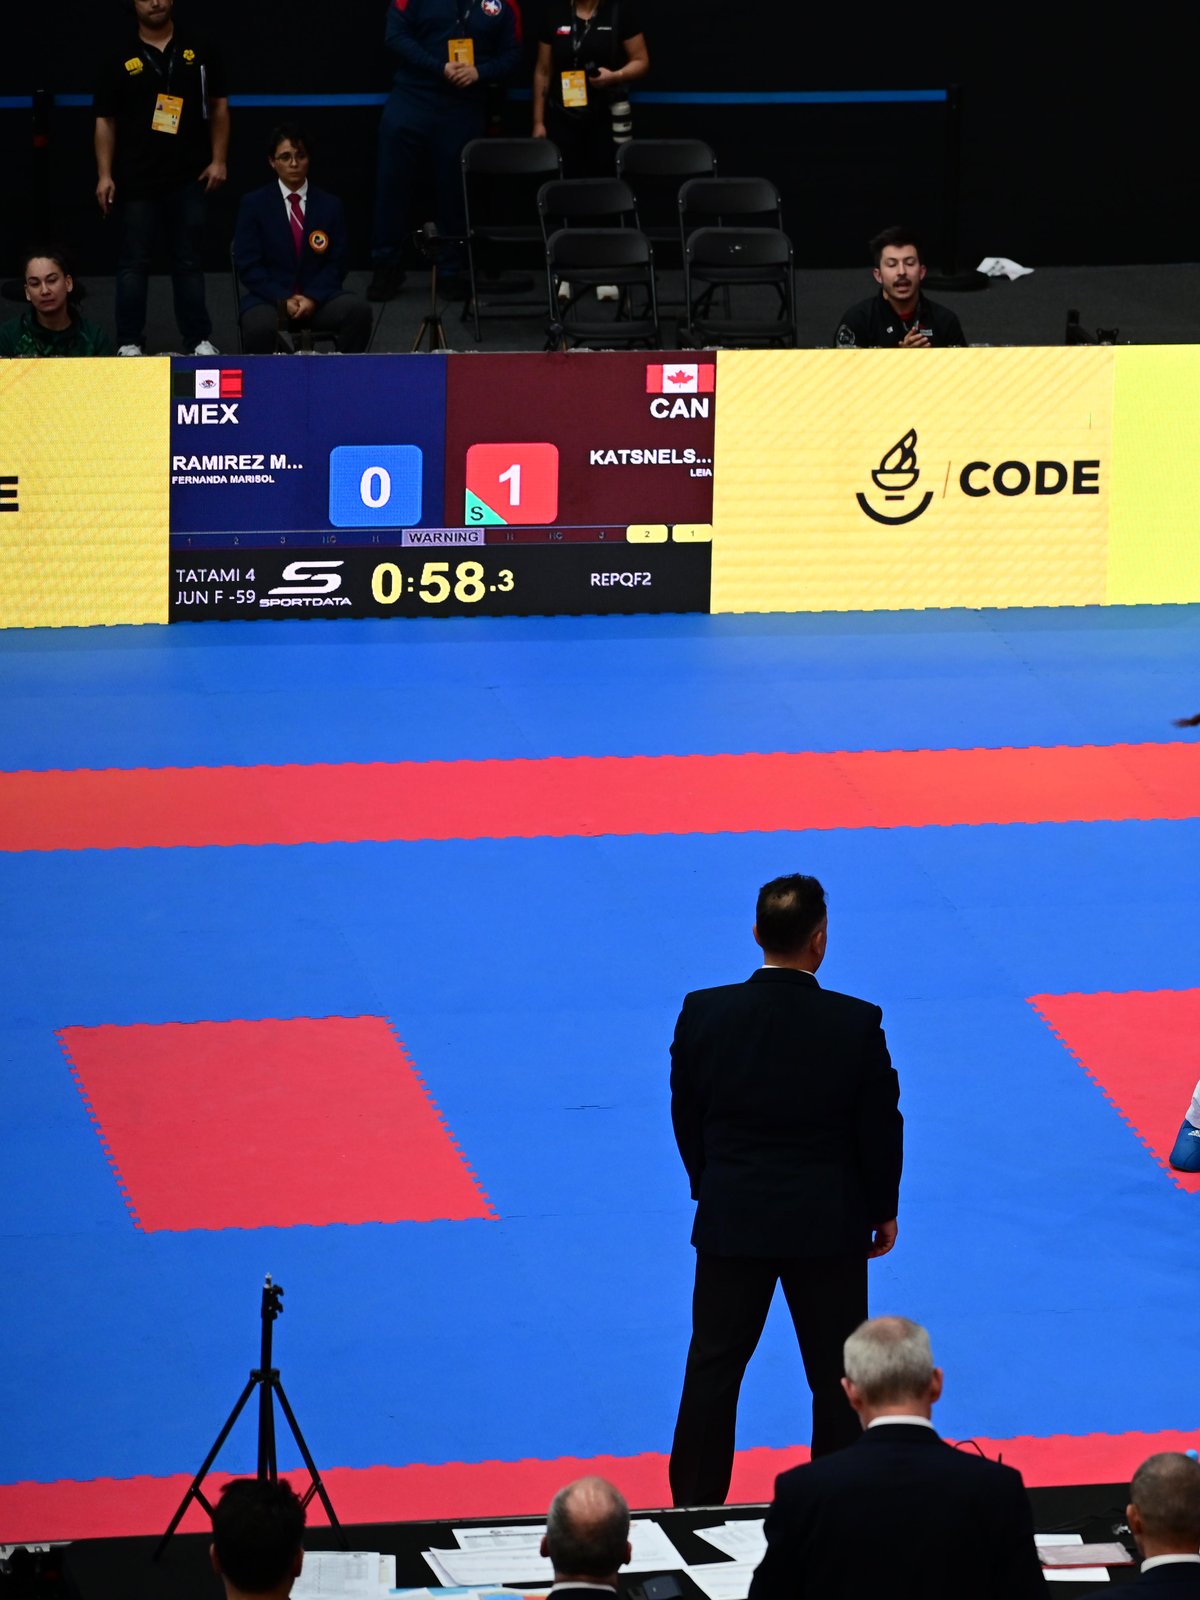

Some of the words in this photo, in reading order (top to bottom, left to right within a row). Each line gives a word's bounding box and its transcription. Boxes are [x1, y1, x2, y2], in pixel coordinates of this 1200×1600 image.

[177, 403, 239, 425] MEX
[649, 397, 709, 419] CAN
[172, 454, 264, 471] RAMIREZ
[589, 448, 712, 465] KATSNELS...
[171, 475, 228, 485] FERNANDA
[230, 474, 275, 484] MARISOL
[690, 468, 713, 477] LEIA
[959, 460, 1101, 497] CODE
[360, 466, 391, 508] 0
[498, 464, 521, 506] 1
[470, 506, 484, 521] S
[409, 531, 479, 543] WARNING
[176, 568, 240, 582] TATAMI
[245, 568, 256, 581] 4
[590, 572, 652, 587] REPQF2
[175, 590, 209, 605] JUN
[214, 591, 224, 604] F
[229, 590, 256, 604] -59
[259, 597, 352, 608] SPORTDATA
